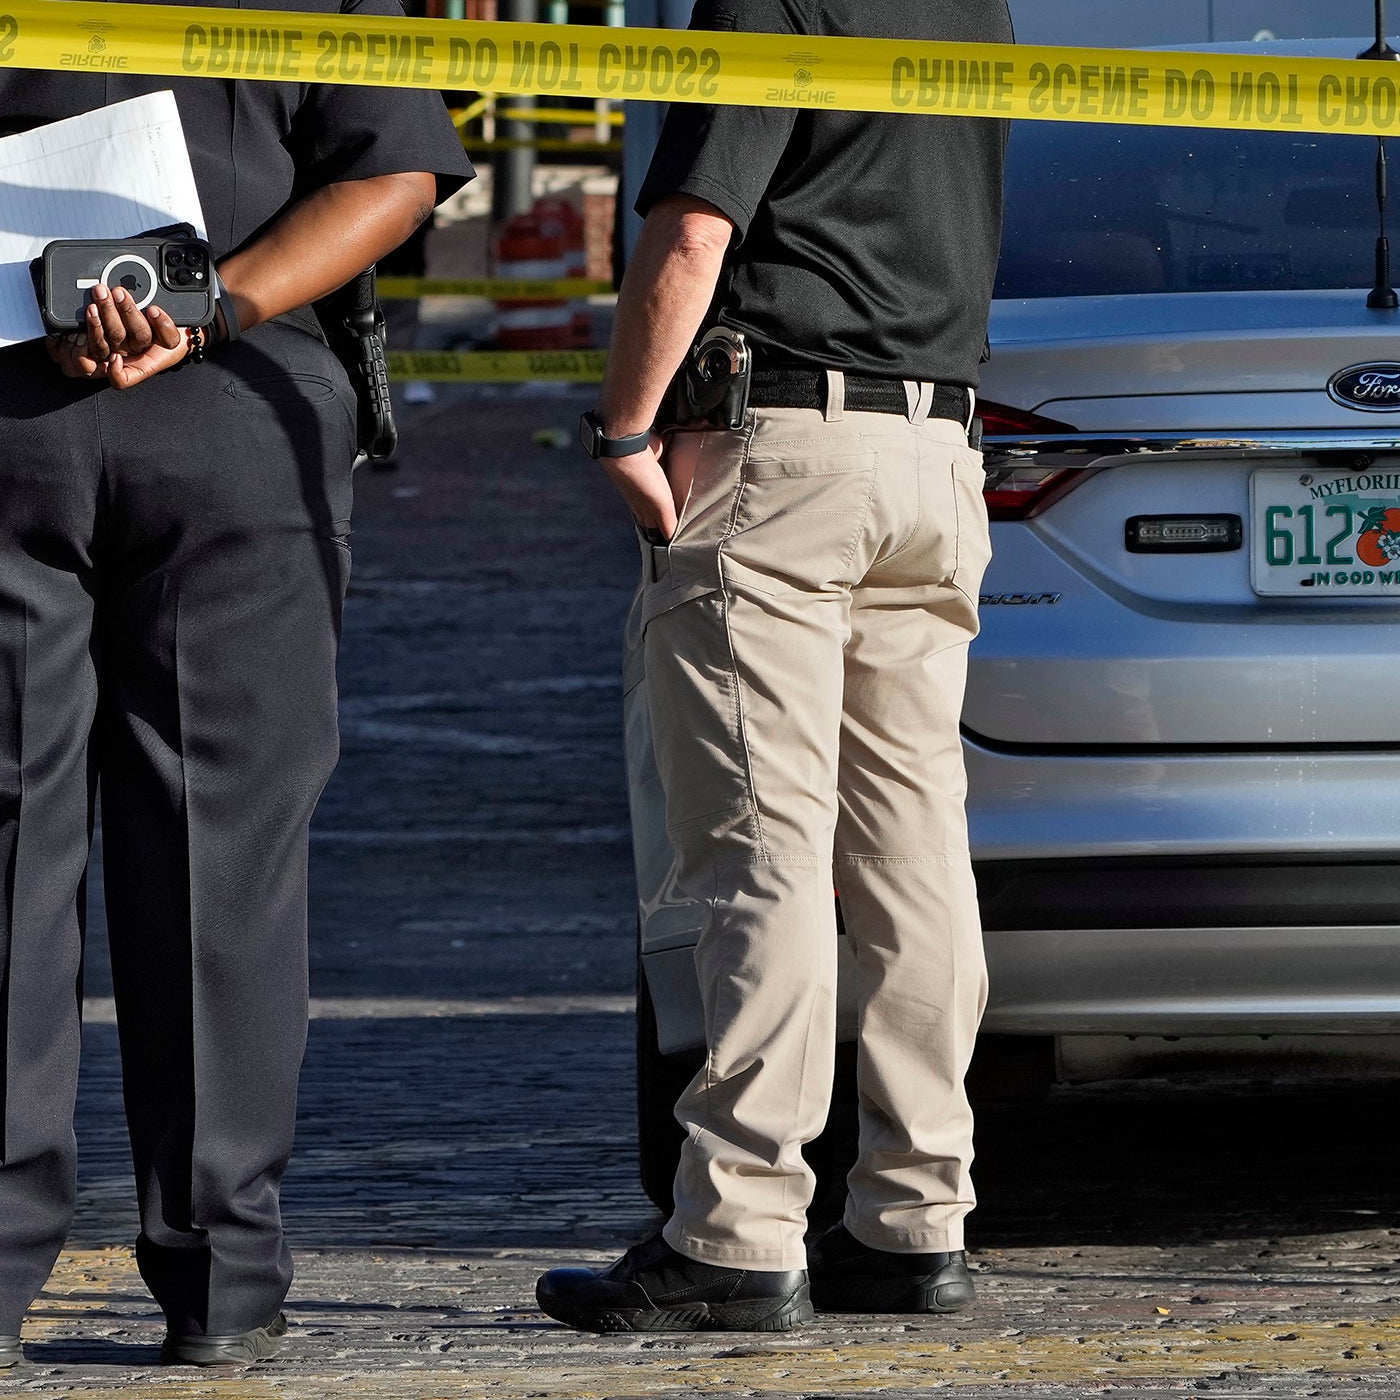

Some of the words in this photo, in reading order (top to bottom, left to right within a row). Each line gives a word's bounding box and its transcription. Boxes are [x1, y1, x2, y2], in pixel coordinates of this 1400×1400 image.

[1266, 504, 1355, 566] 612
[1311, 571, 1331, 585] IN
[1334, 570, 1375, 586] GOD
